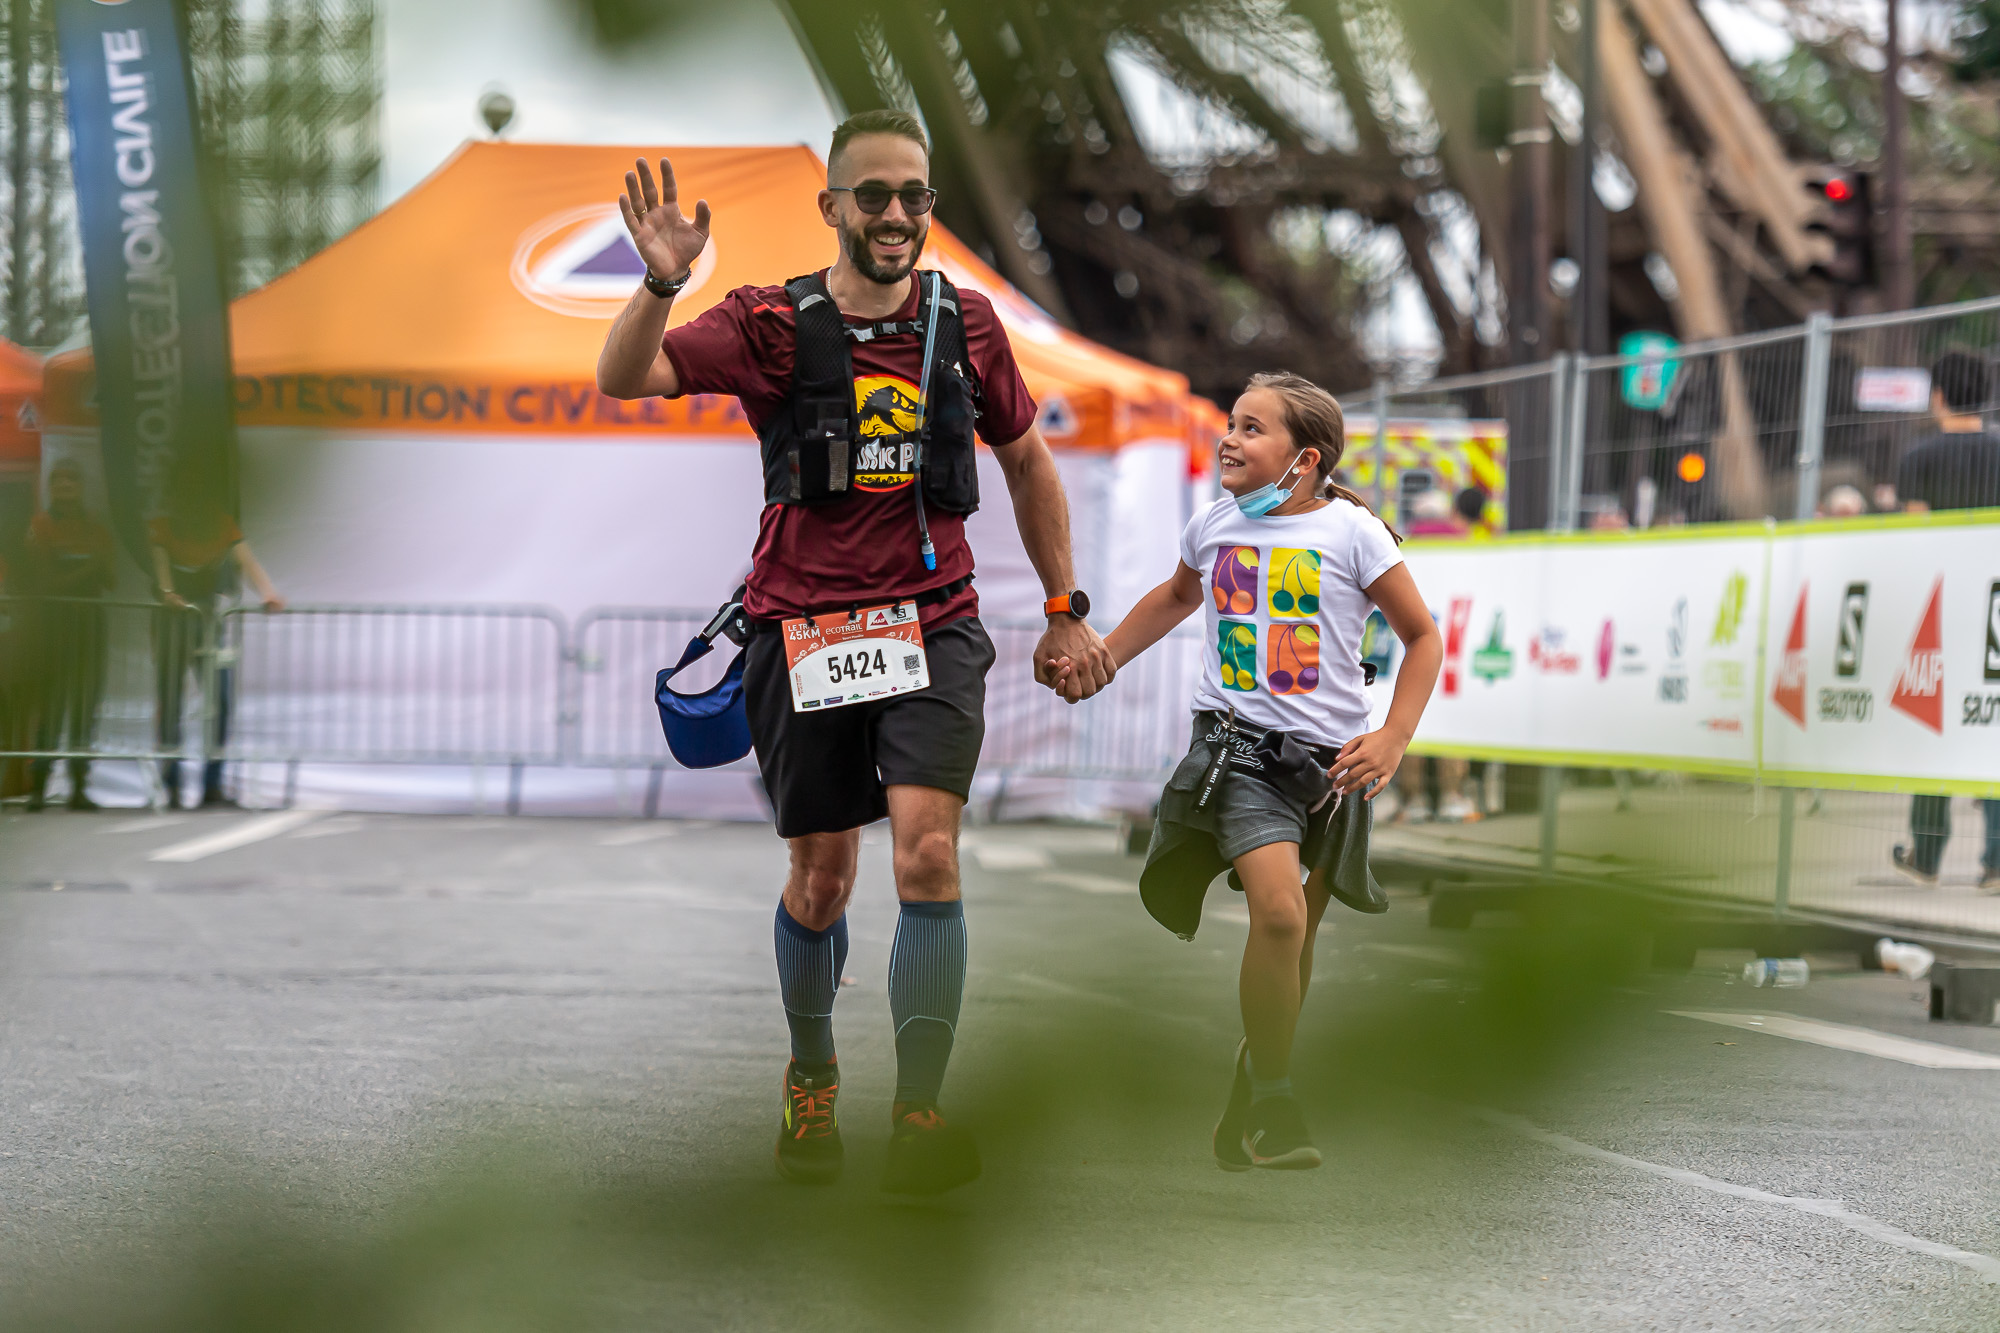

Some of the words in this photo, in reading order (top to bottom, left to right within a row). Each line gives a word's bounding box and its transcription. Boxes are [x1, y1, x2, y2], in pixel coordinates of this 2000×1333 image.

[787, 624, 797, 632] LE
[799, 622, 819, 631] TRL
[789, 627, 821, 640] 45KM
[827, 648, 887, 684] 5424
